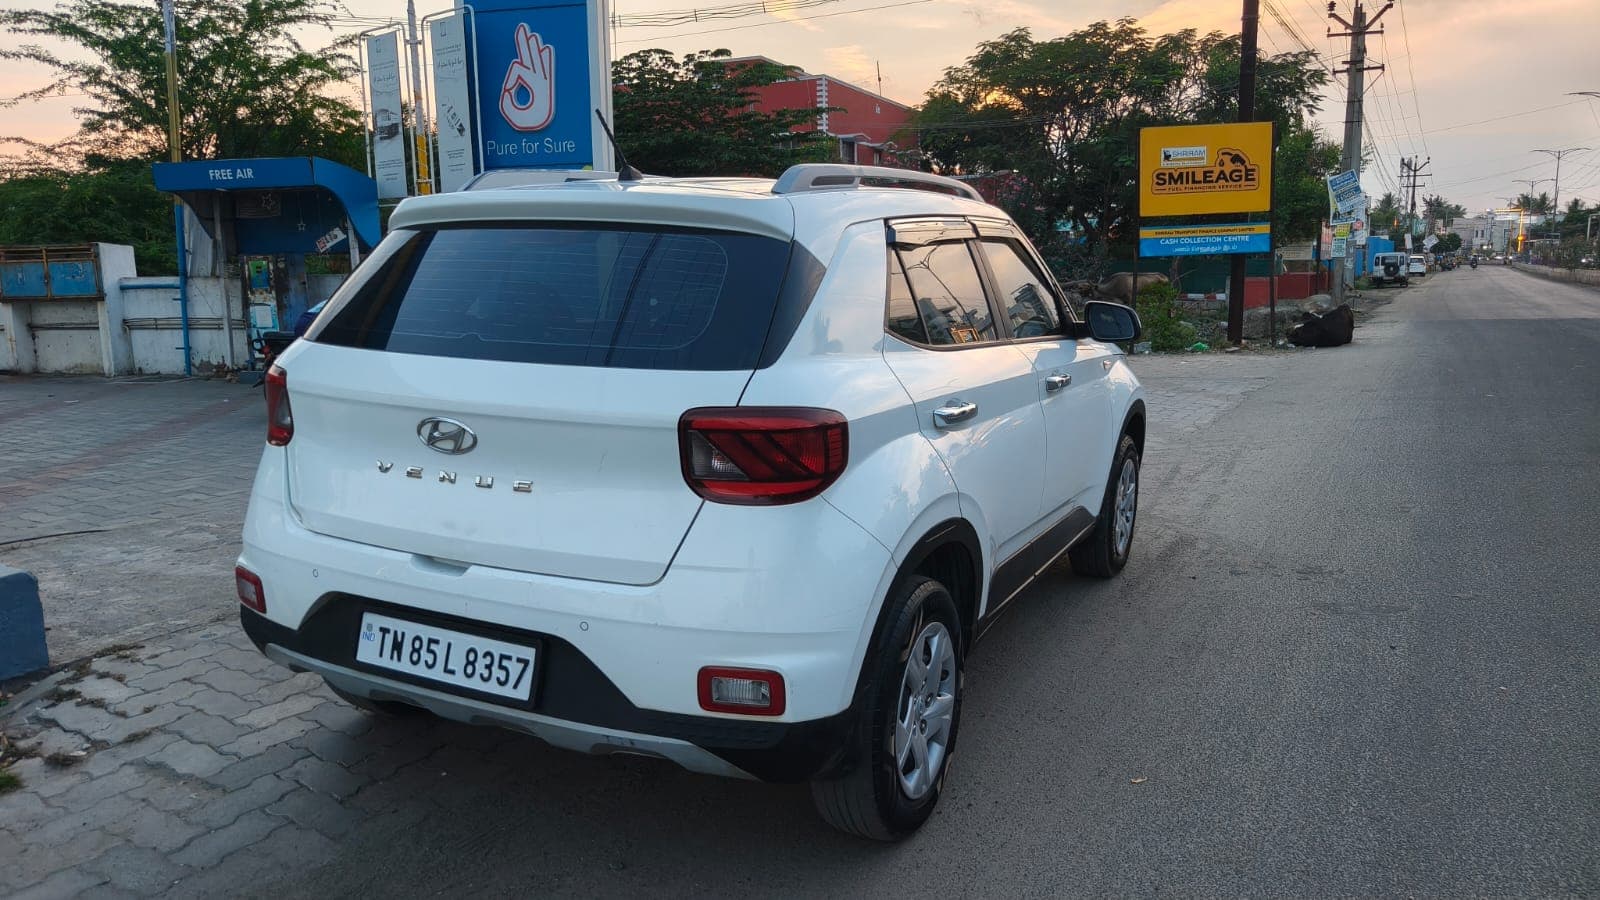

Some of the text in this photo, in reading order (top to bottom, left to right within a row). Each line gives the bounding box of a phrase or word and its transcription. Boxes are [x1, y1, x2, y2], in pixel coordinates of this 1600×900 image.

[487, 138, 576, 156] Pure for Sure
[208, 168, 254, 180] FREE AIR
[1155, 167, 1256, 186] SMILEAGE
[376, 459, 534, 493] VENUE
[362, 631, 376, 642] IND
[463, 647, 530, 690] 8357
